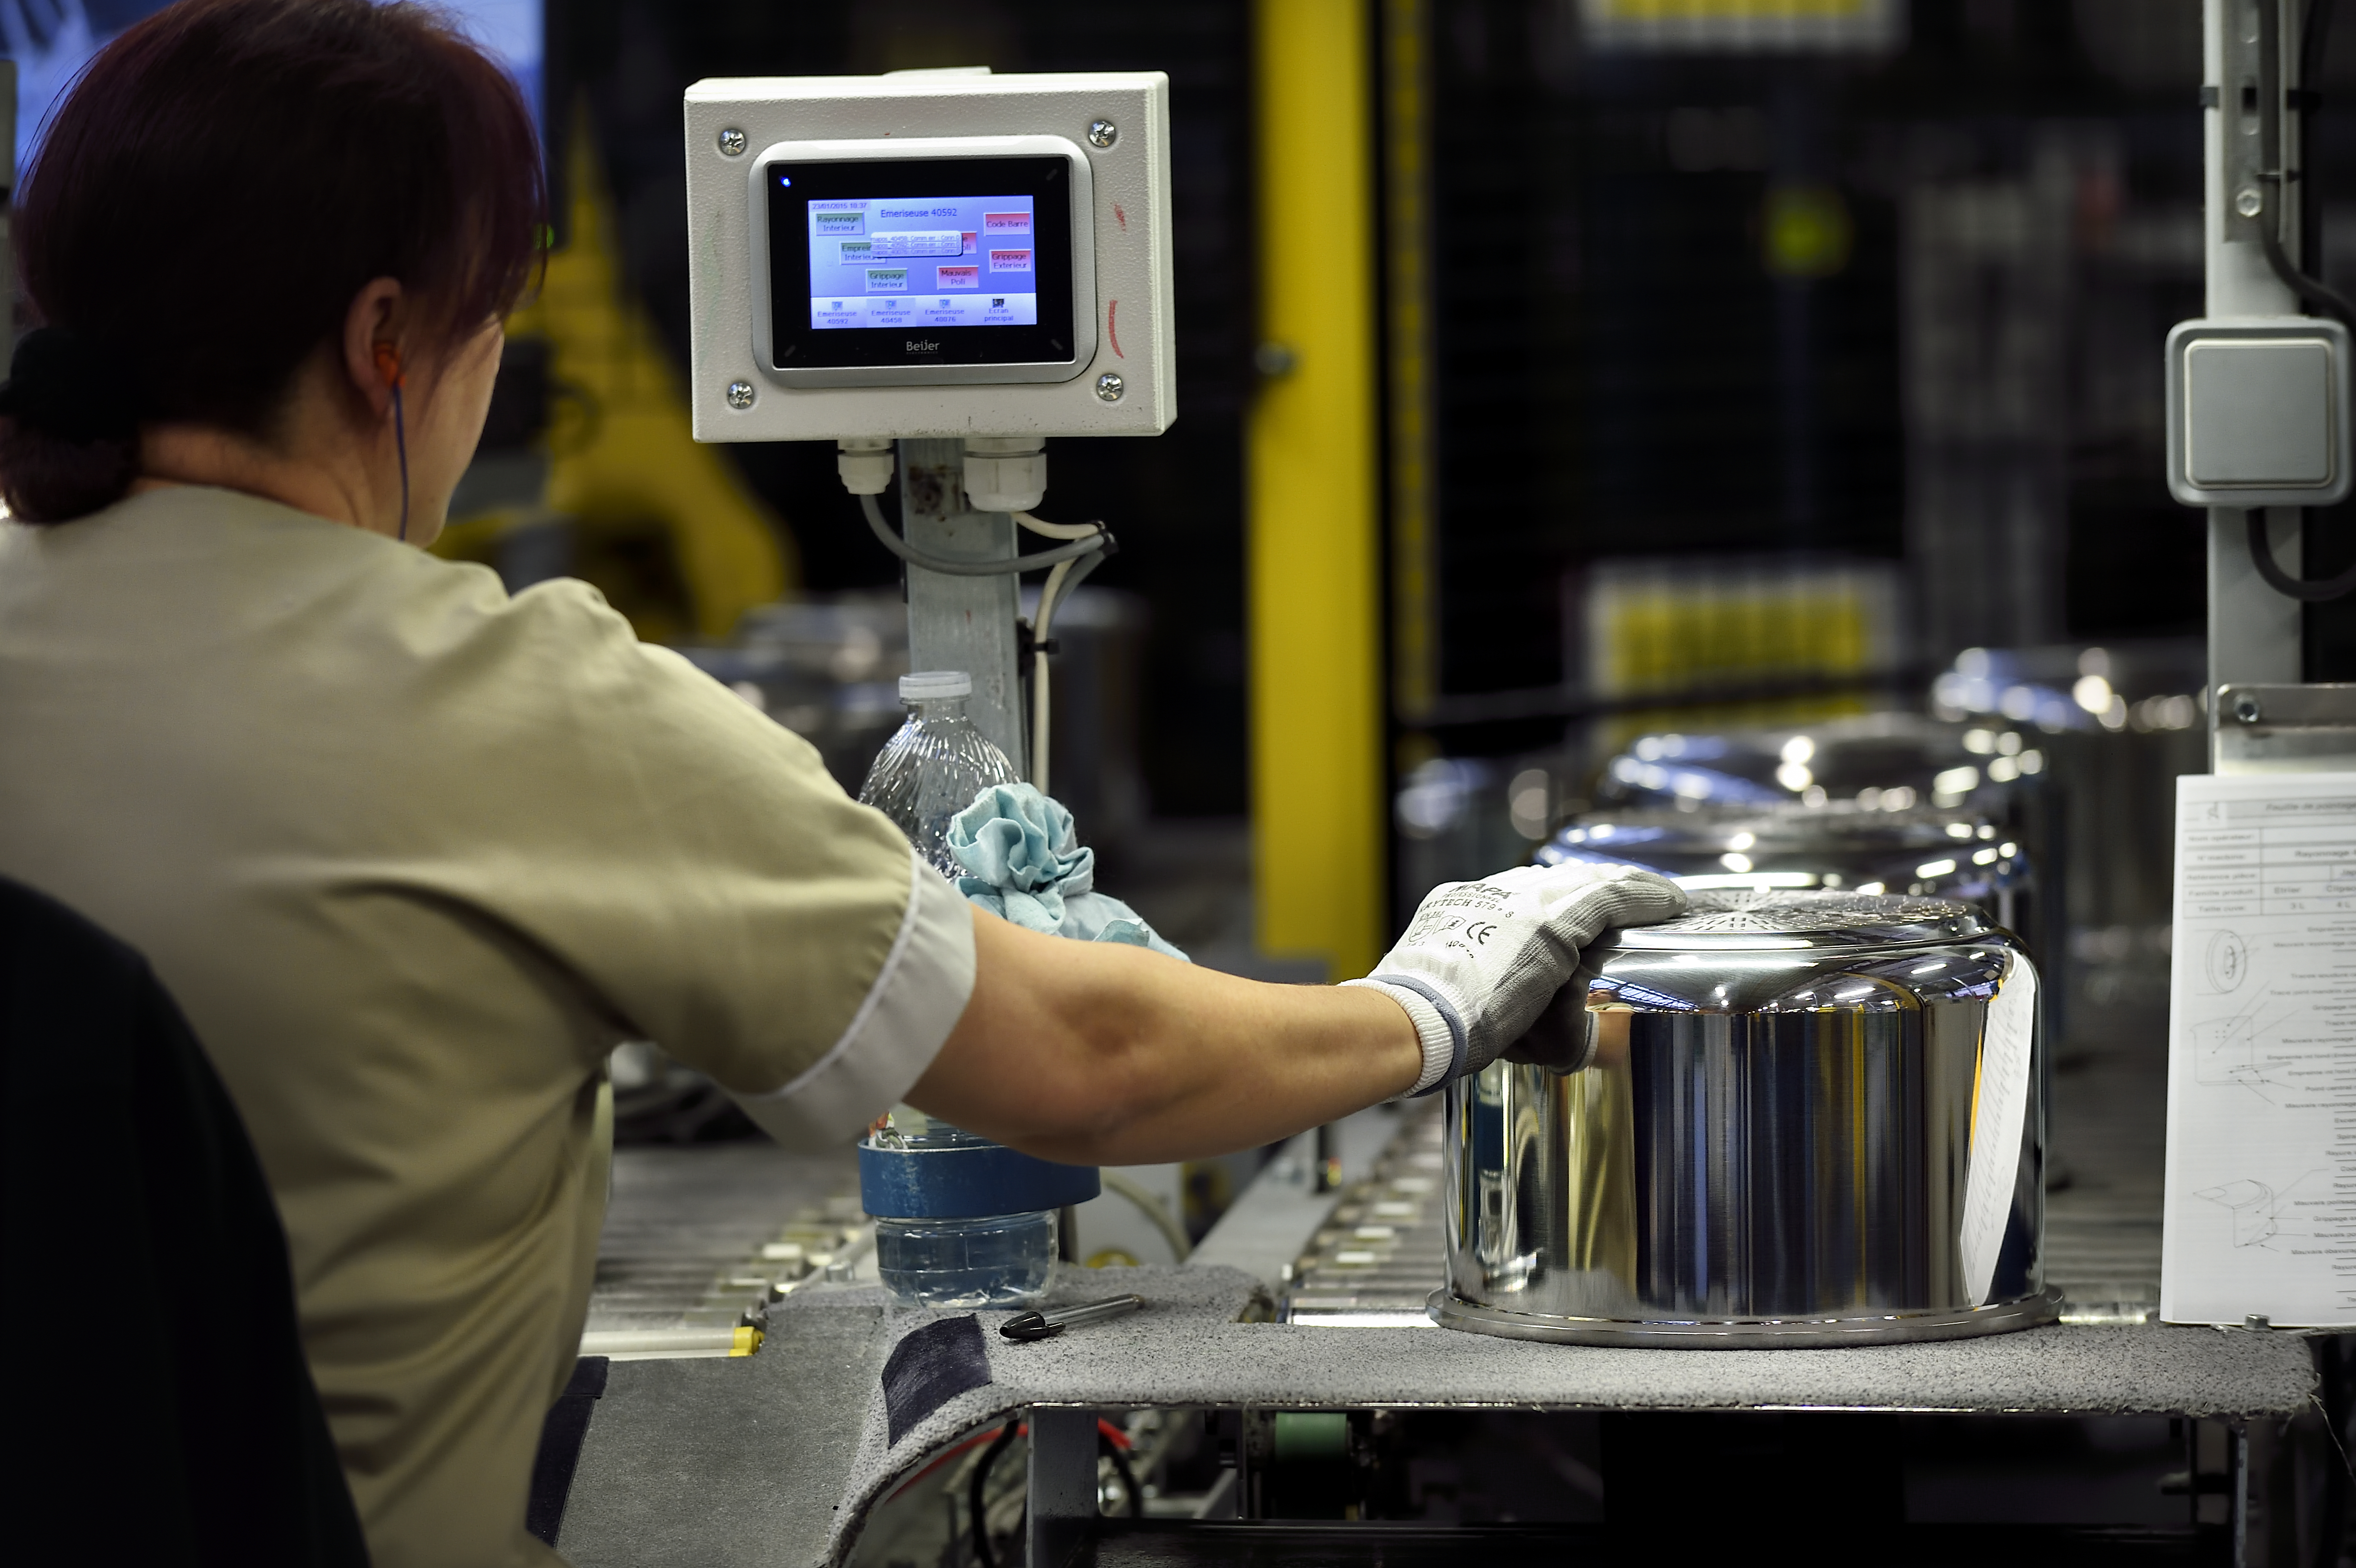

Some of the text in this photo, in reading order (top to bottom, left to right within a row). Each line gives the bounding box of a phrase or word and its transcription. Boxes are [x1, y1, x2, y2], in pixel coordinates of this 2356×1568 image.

[881, 208, 958, 218] Emeriseuse 40592
[992, 253, 1026, 261] Grippage
[869, 272, 904, 280] Grippage
[906, 339, 940, 351] Beijer
[1474, 901, 1496, 910] 579
